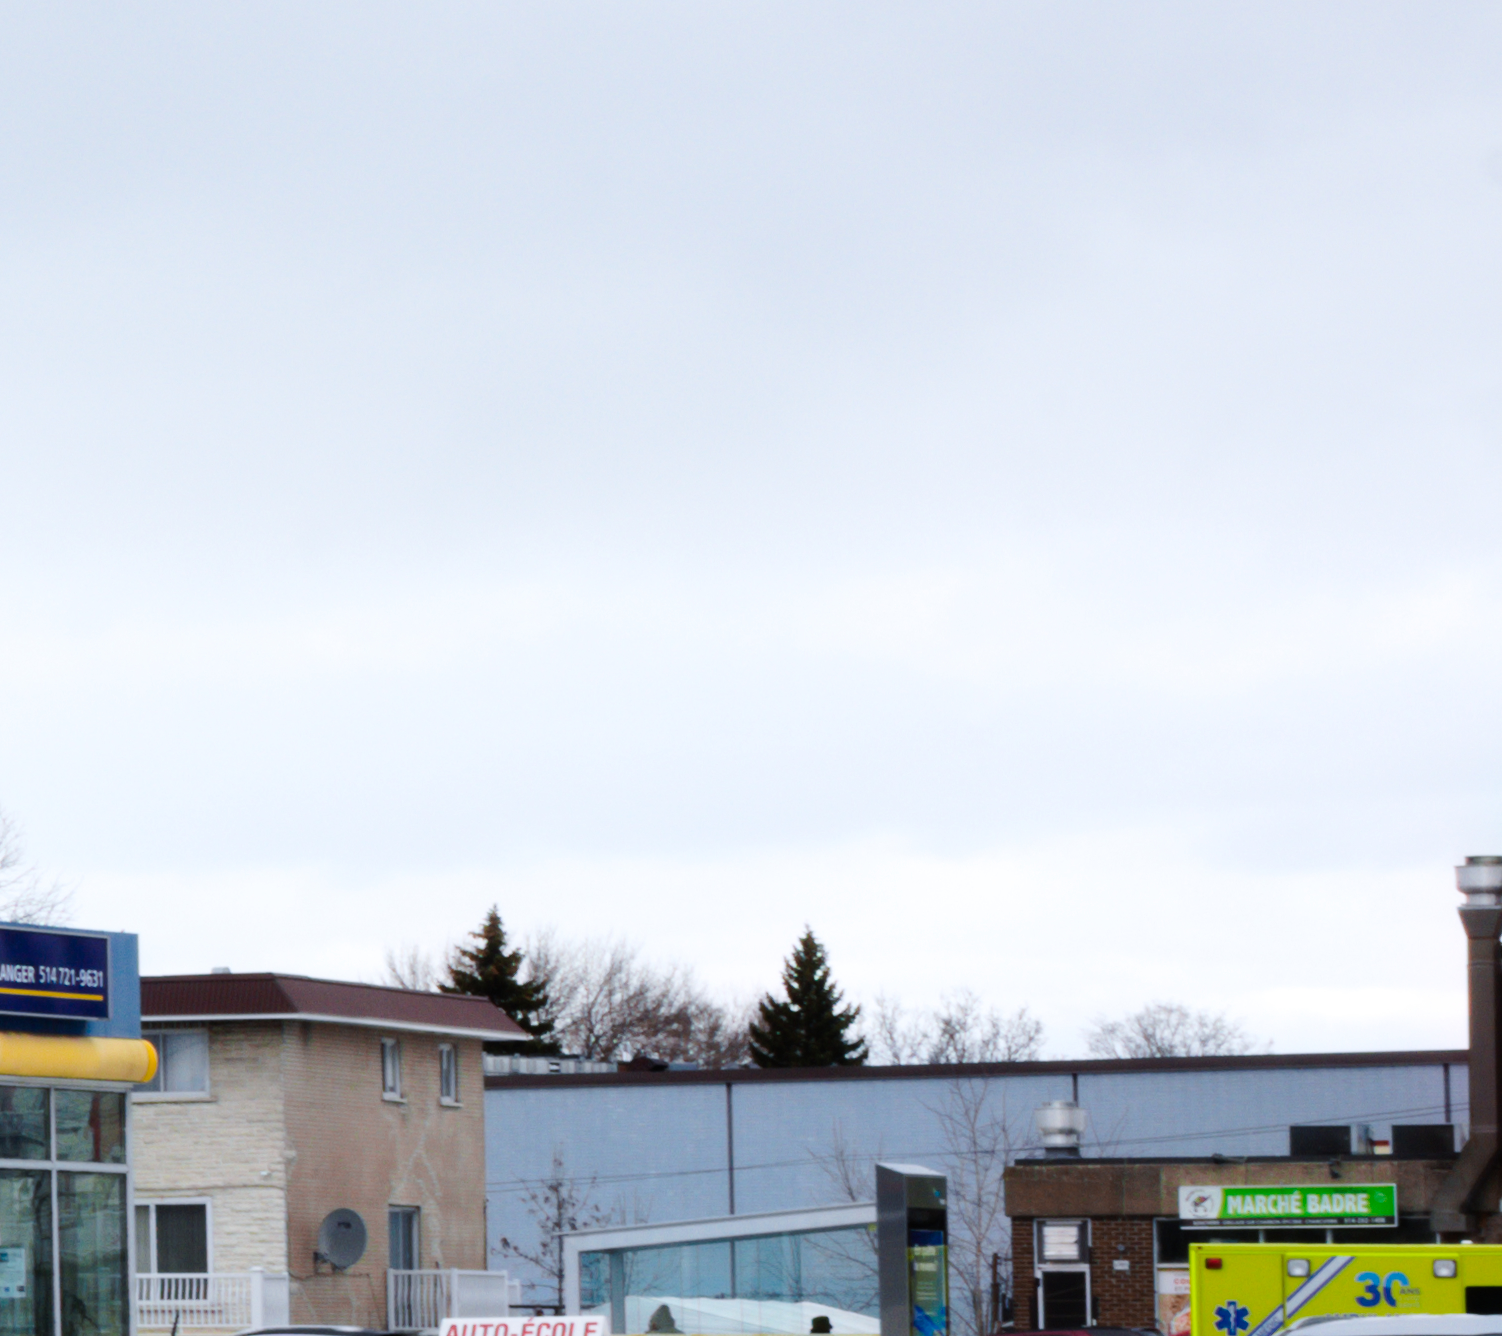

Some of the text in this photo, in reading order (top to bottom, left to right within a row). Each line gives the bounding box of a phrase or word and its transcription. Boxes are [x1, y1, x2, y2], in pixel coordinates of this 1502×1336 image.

[39, 965, 57, 983] 514
[58, 966, 104, 989] 721-9631
[1226, 1190, 1304, 1215] MARCHÉ
[1306, 1192, 1371, 1214] BADRE
